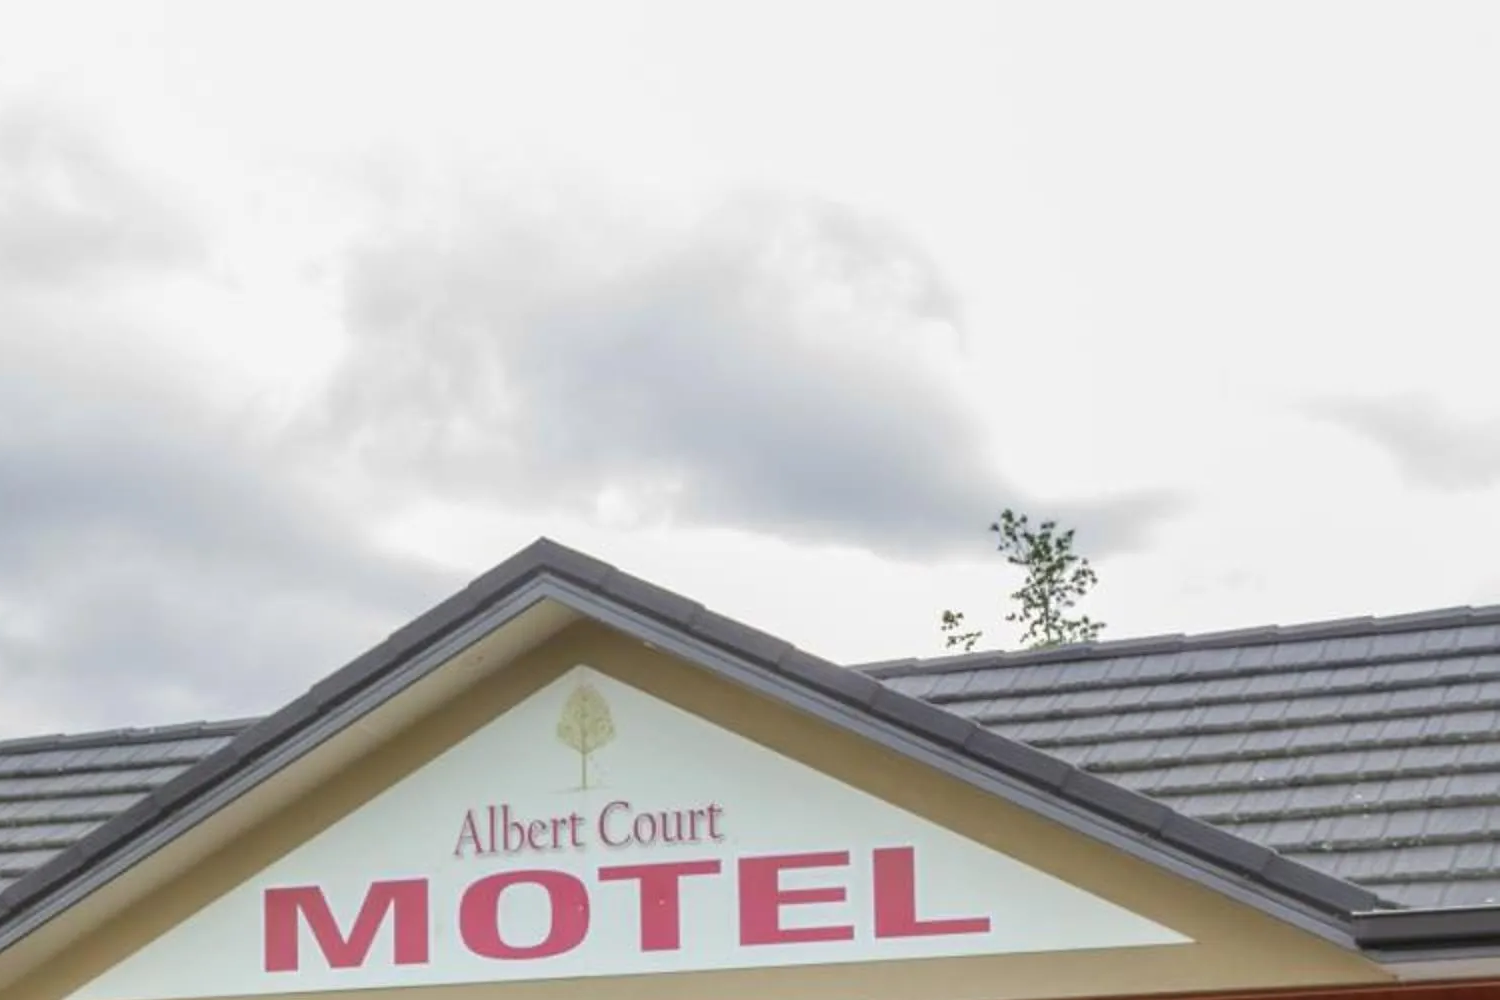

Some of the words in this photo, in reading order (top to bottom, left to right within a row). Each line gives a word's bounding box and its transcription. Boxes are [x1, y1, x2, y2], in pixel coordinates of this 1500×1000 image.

[453, 803, 586, 858] Albert
[599, 800, 725, 848] Court
[264, 846, 991, 972] MOTEL
